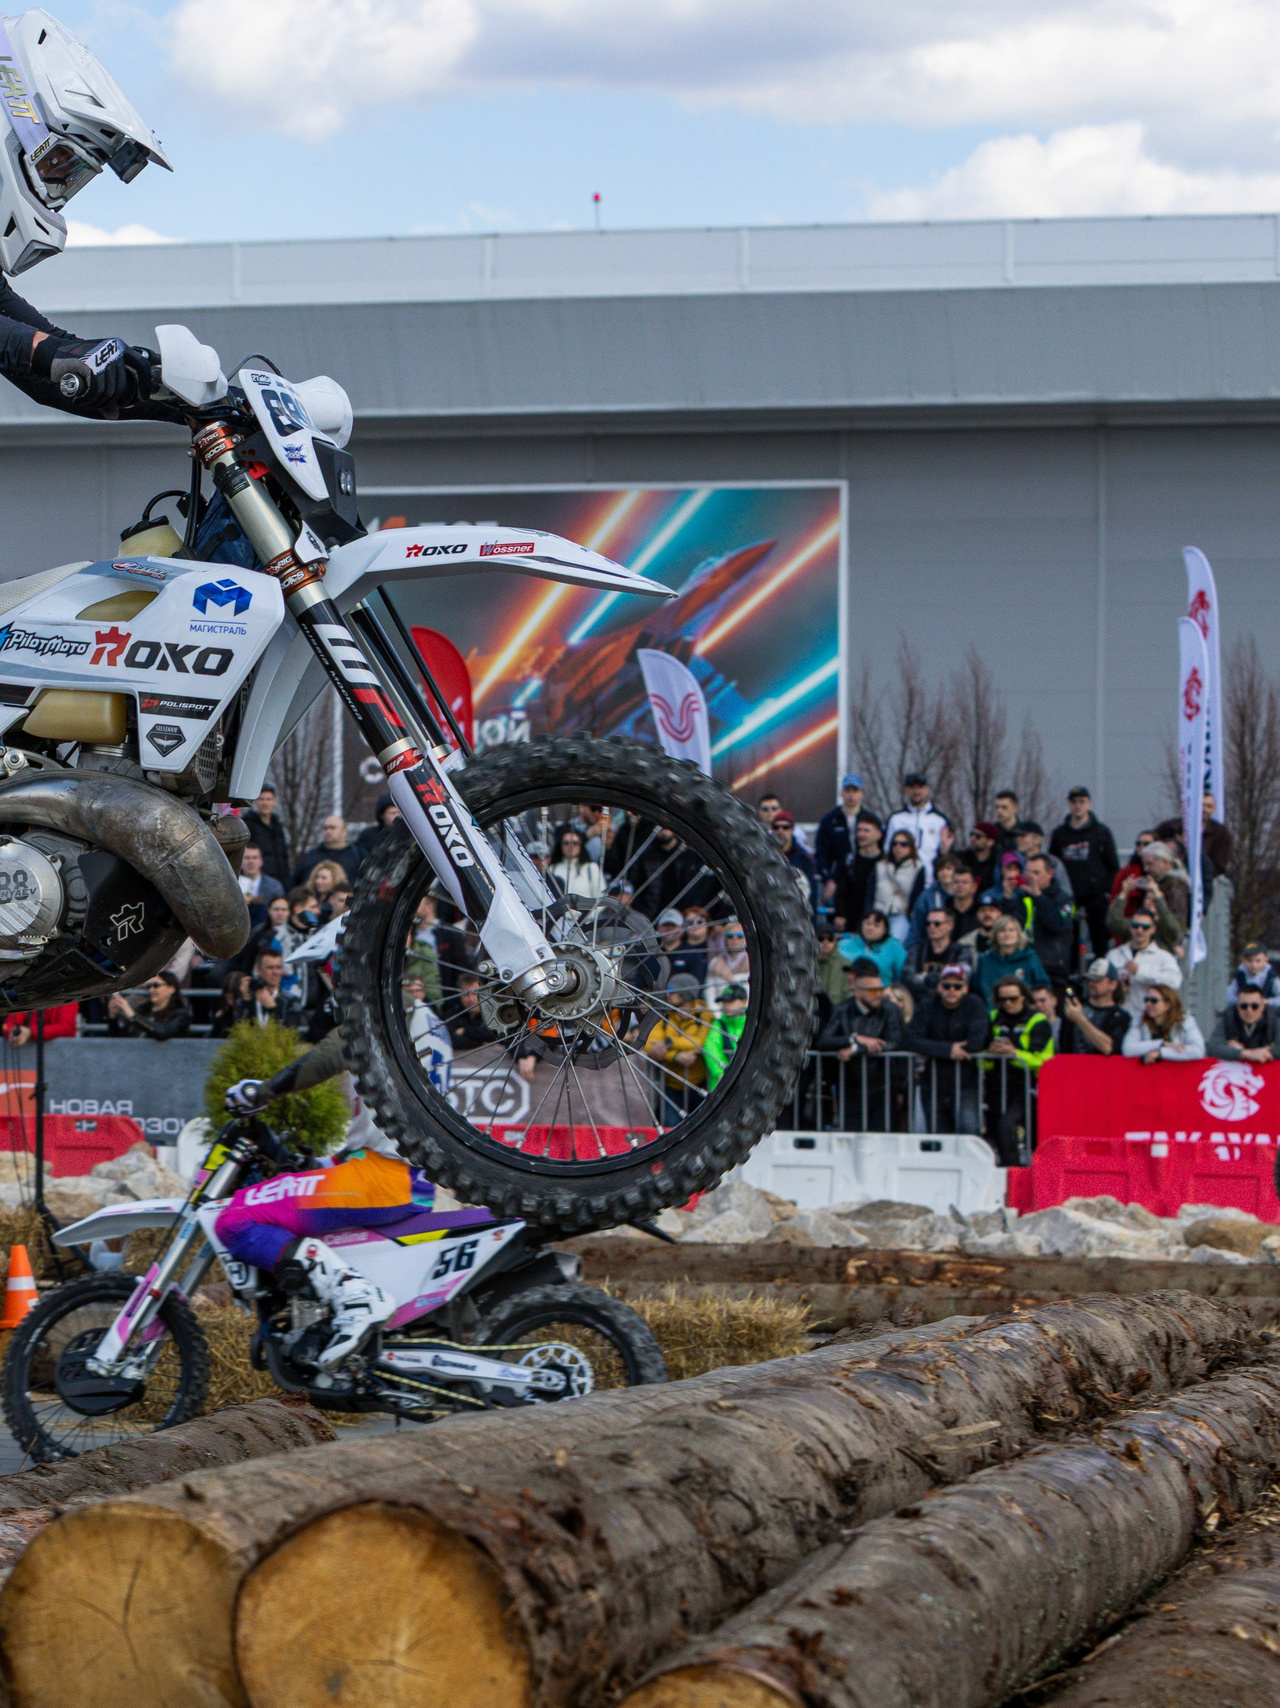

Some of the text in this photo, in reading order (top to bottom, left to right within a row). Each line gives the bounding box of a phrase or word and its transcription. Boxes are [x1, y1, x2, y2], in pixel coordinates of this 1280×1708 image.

[30, 137, 51, 162] LEATT
[189, 624, 247, 636] МАГИСТРАЛЬ
[159, 700, 215, 711] POLISPORT
[49, 1099, 134, 1116] НОВАЯ
[244, 1175, 326, 1207] LEATT
[431, 1239, 480, 1280] 56
